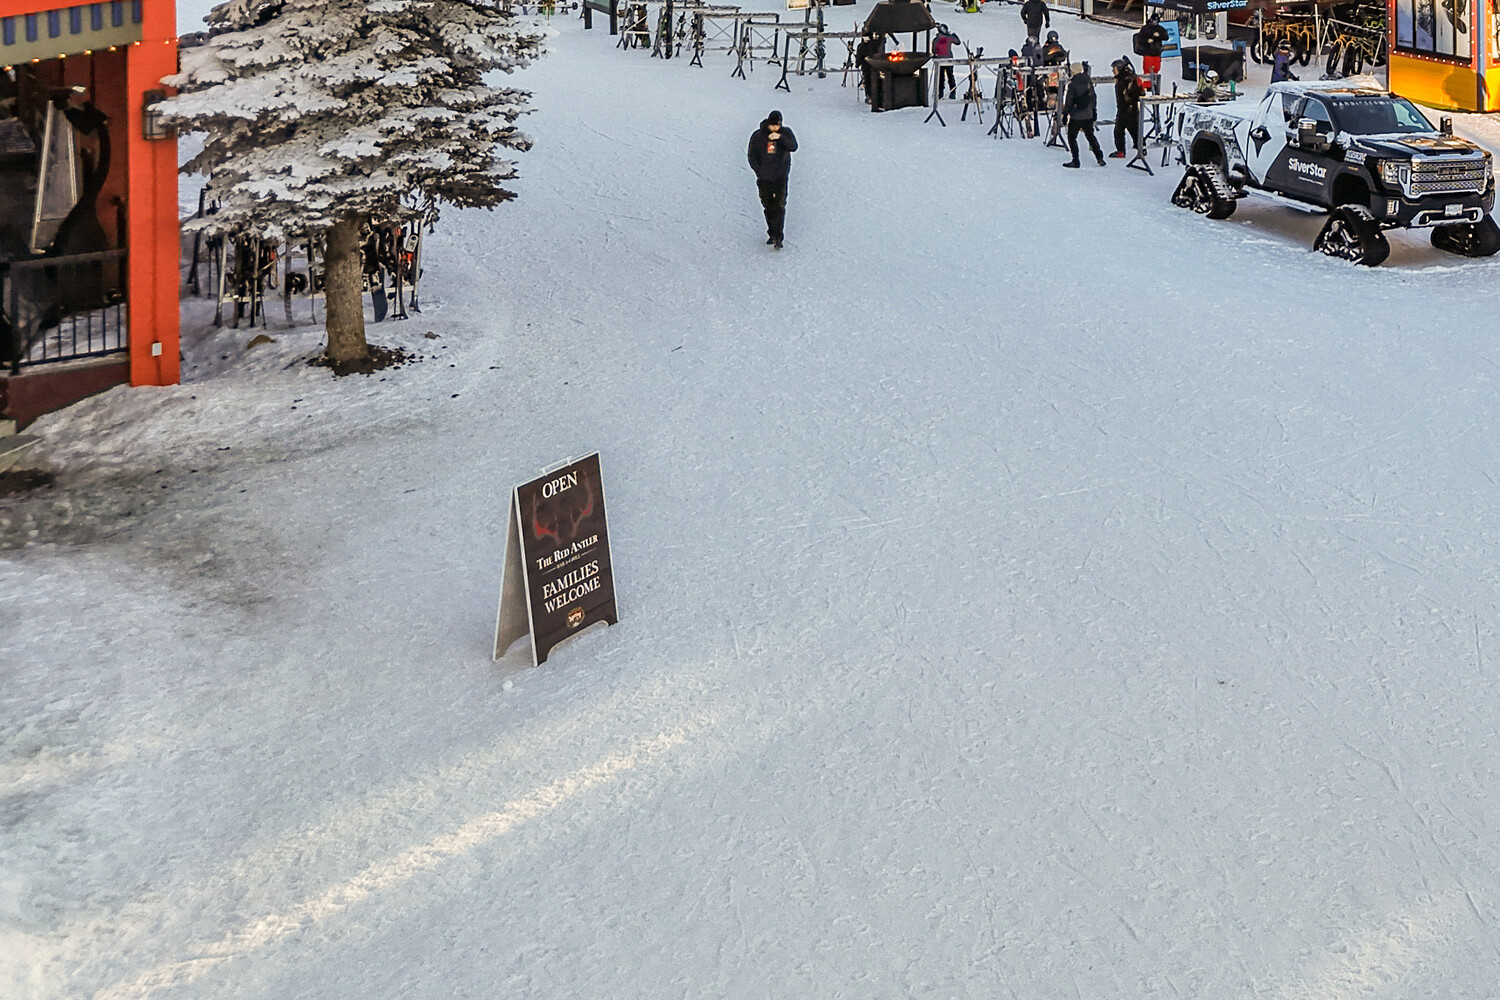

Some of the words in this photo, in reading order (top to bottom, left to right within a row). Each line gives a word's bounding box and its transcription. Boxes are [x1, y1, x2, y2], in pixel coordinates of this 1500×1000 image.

[1207, 0, 1248, 10] SilverStar
[1288, 157, 1327, 178] SilverStar
[542, 470, 578, 499] OPEN
[542, 559, 599, 600] FAMILIES
[544, 576, 601, 614] WELCOME
